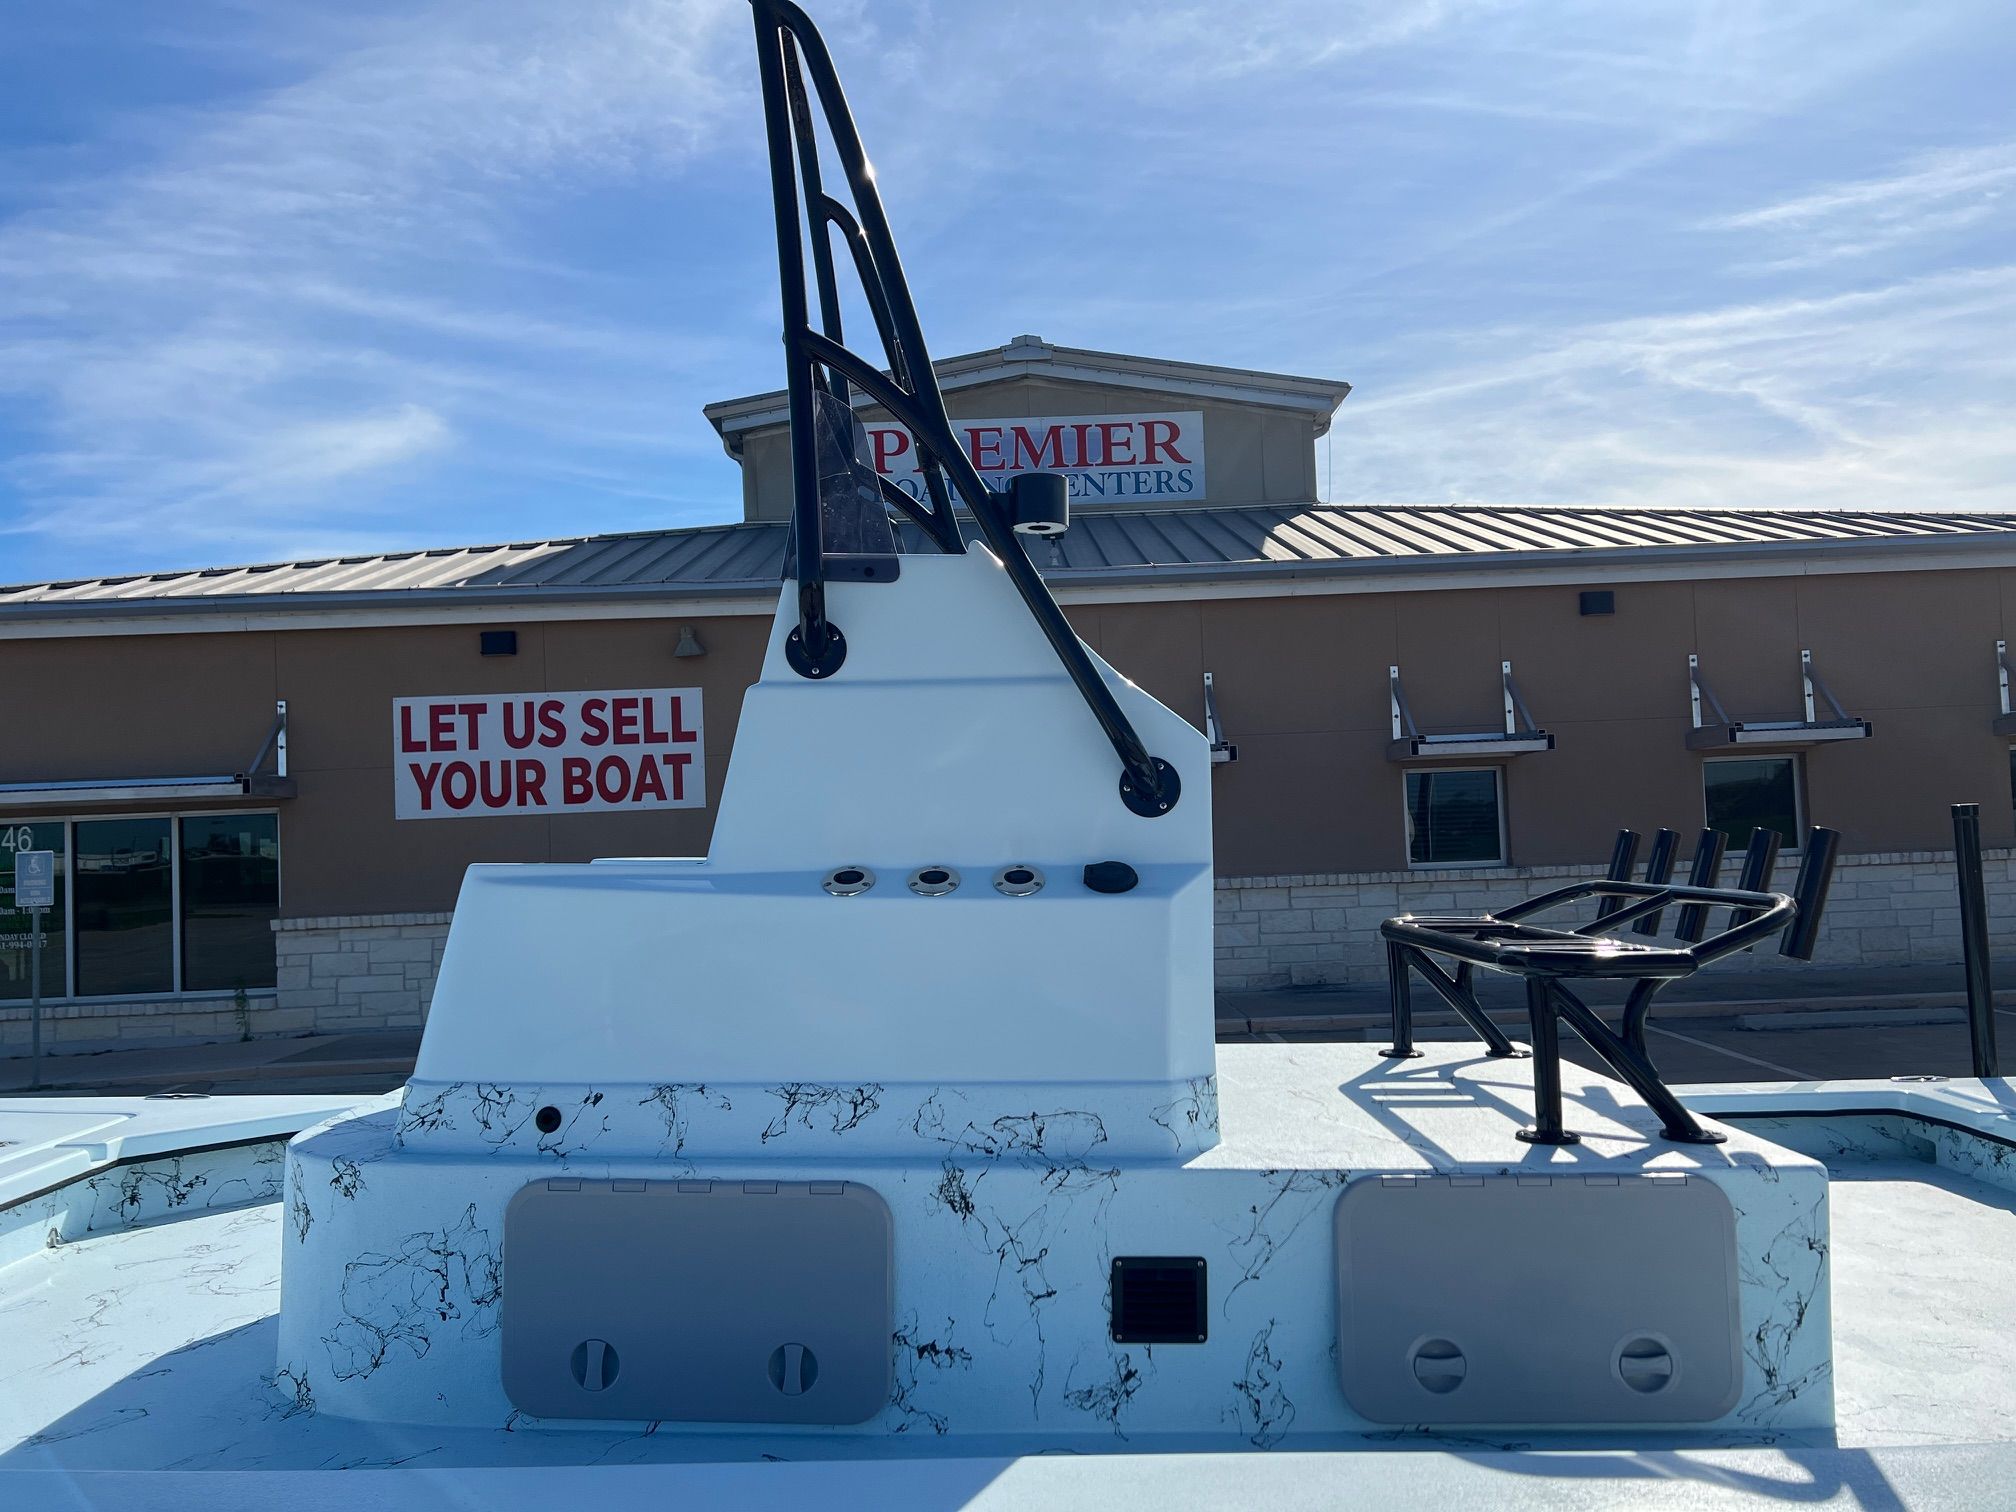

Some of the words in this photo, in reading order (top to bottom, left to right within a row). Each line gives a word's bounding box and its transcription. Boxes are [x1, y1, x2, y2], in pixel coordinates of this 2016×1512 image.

[868, 419, 1192, 474] PEMIER
[1068, 468, 1194, 497] ENTERS
[401, 703, 488, 753] LET
[503, 700, 567, 750] US
[580, 696, 697, 747] SELL
[408, 759, 548, 811] YOUR
[562, 753, 692, 805] BOAT
[1, 826, 32, 852] 46
[19, 932, 47, 941] CLOD
